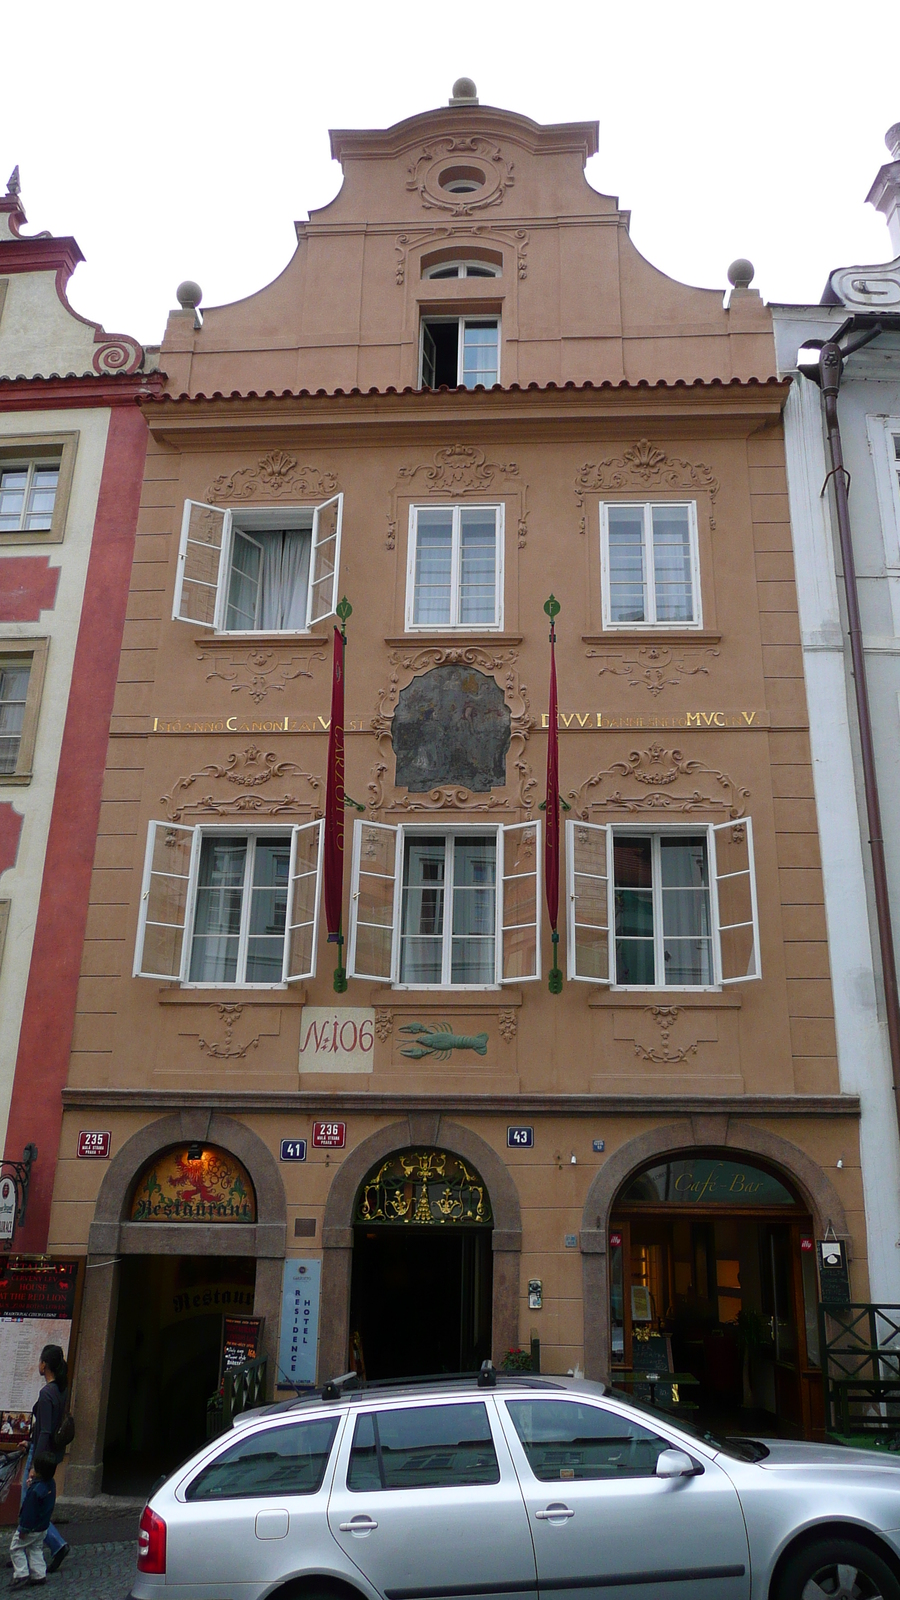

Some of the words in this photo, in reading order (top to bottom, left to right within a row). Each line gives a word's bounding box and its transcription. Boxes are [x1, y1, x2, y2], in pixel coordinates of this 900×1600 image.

[319, 1124, 338, 1135] 236
[84, 1133, 104, 1145] 235
[513, 1130, 528, 1143] 43
[287, 1143, 300, 1157] 41
[136, 1199, 251, 1218] Restaurant
[19, 1283, 48, 1292] HOUSE
[10, 1292, 26, 1301] THE
[27, 1293, 45, 1302] RED
[46, 1294, 67, 1303] LION
[302, 1299, 311, 1344] HOTEL
[290, 1289, 301, 1372] RESIDENCE
